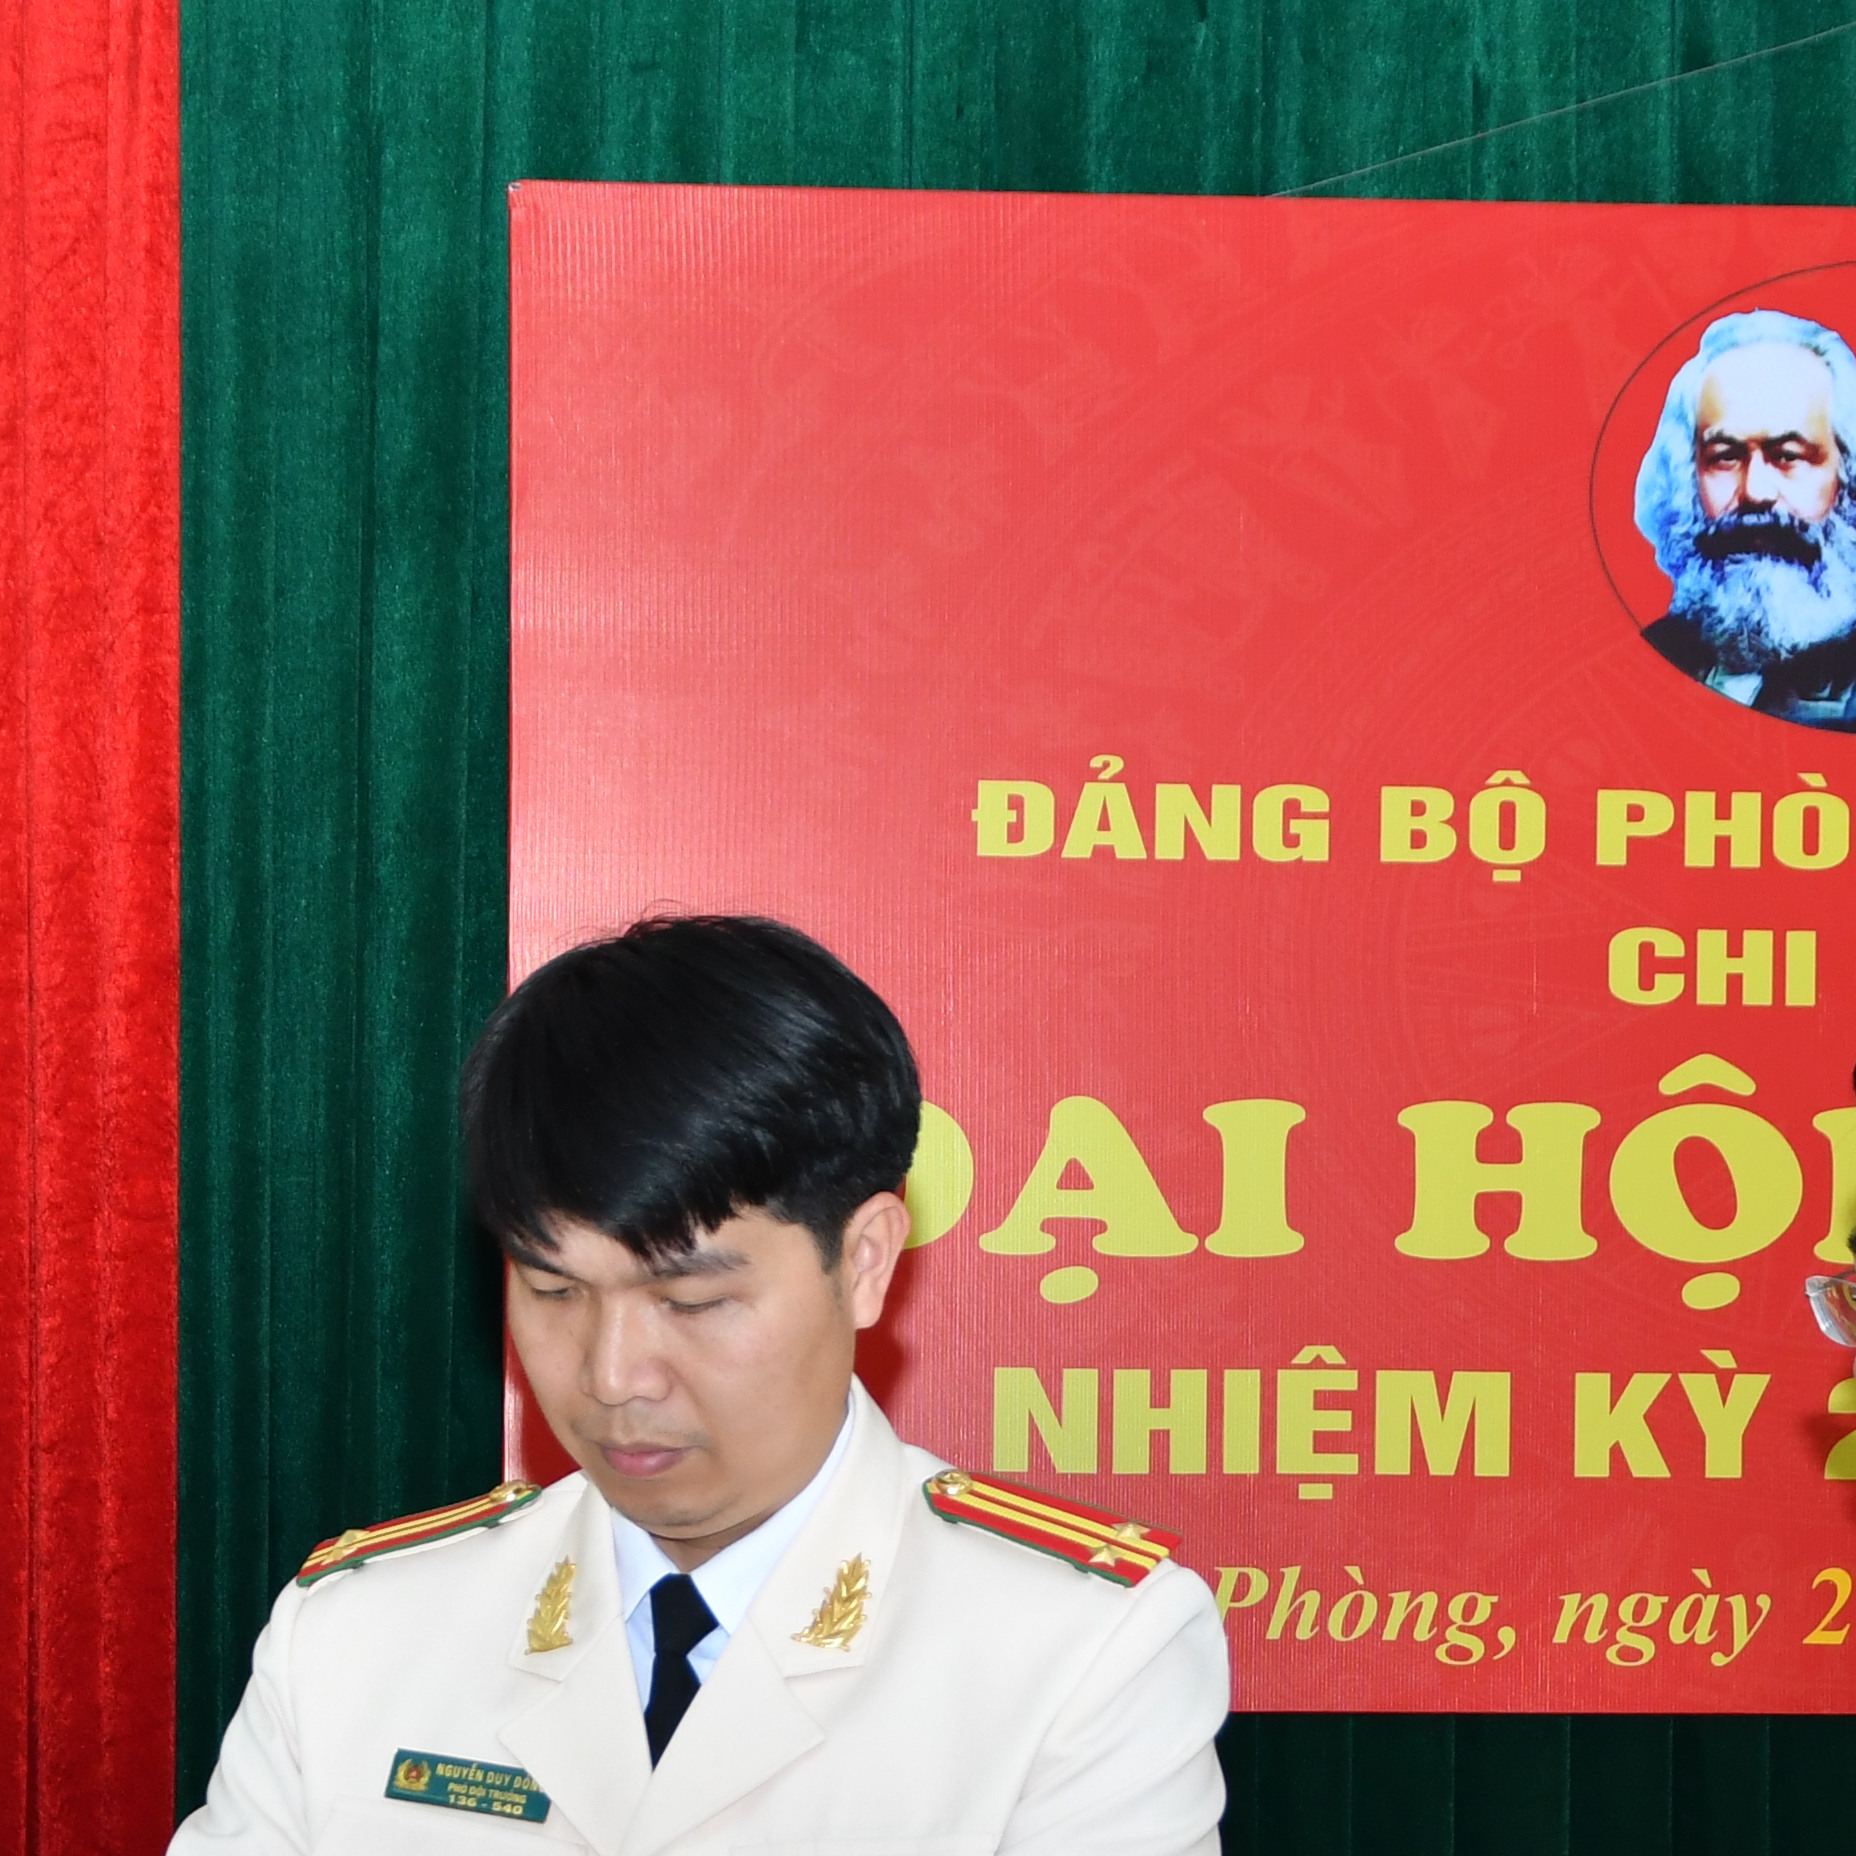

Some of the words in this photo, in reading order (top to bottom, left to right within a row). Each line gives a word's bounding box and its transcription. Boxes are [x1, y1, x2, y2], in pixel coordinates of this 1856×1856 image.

[971, 754, 1331, 862] ĐẢNG
[1380, 769, 1547, 882] BỘ
[1608, 927, 1817, 1007] CHI
[904, 1095, 1306, 1304] ẠI
[993, 1345, 1511, 1500] NHIỆM
[1574, 1350, 1771, 1479] KỲ
[1214, 1565, 1518, 1666] Phòng,
[1552, 1567, 1771, 1667] ngày
